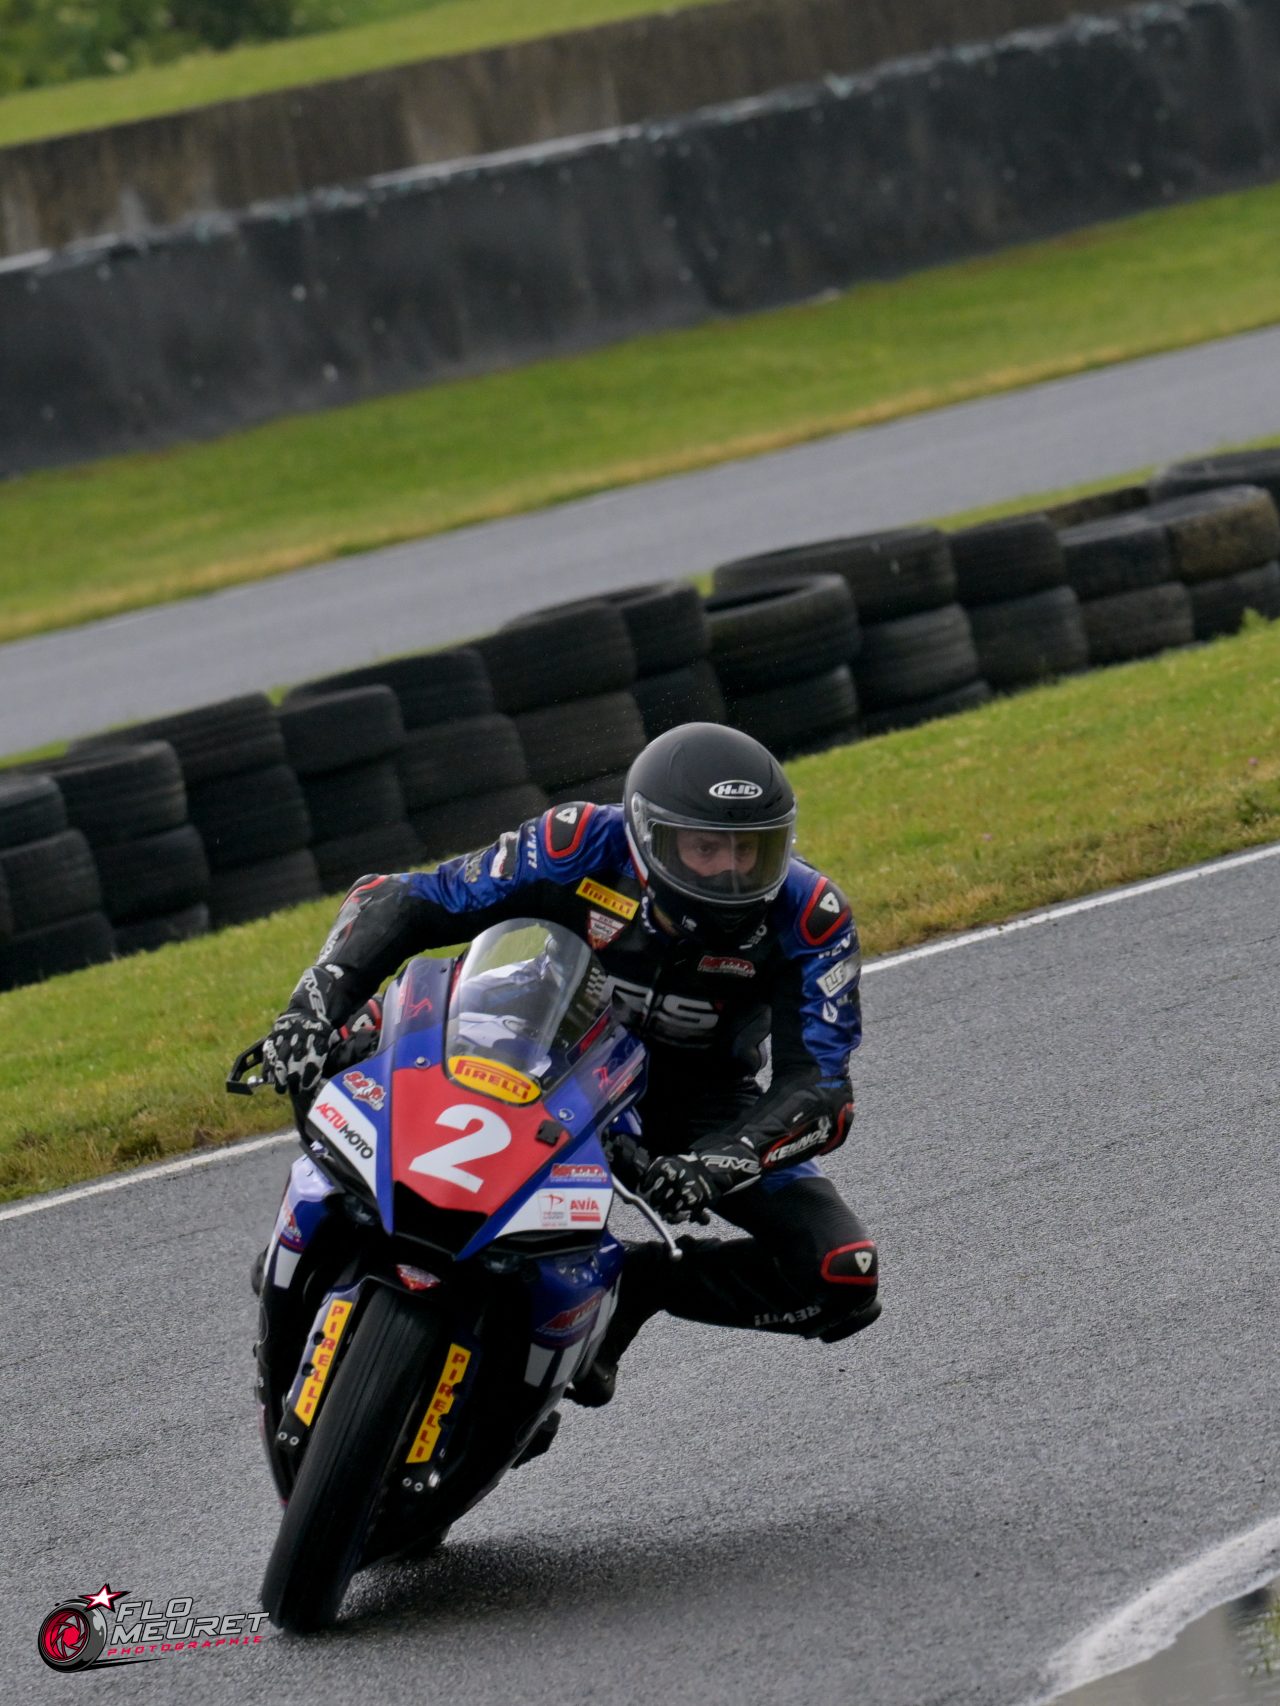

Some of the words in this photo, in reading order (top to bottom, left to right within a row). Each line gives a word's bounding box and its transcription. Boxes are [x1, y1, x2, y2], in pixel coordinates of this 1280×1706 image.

[717, 784, 757, 795] HJC
[582, 882, 634, 915] PIRELLI
[454, 1059, 532, 1100] PIRELLI
[408, 1103, 512, 1194] 2
[700, 1154, 762, 1174] FIVE
[303, 1305, 345, 1414] PIRELLI
[416, 1352, 466, 1458] PIRELLI
